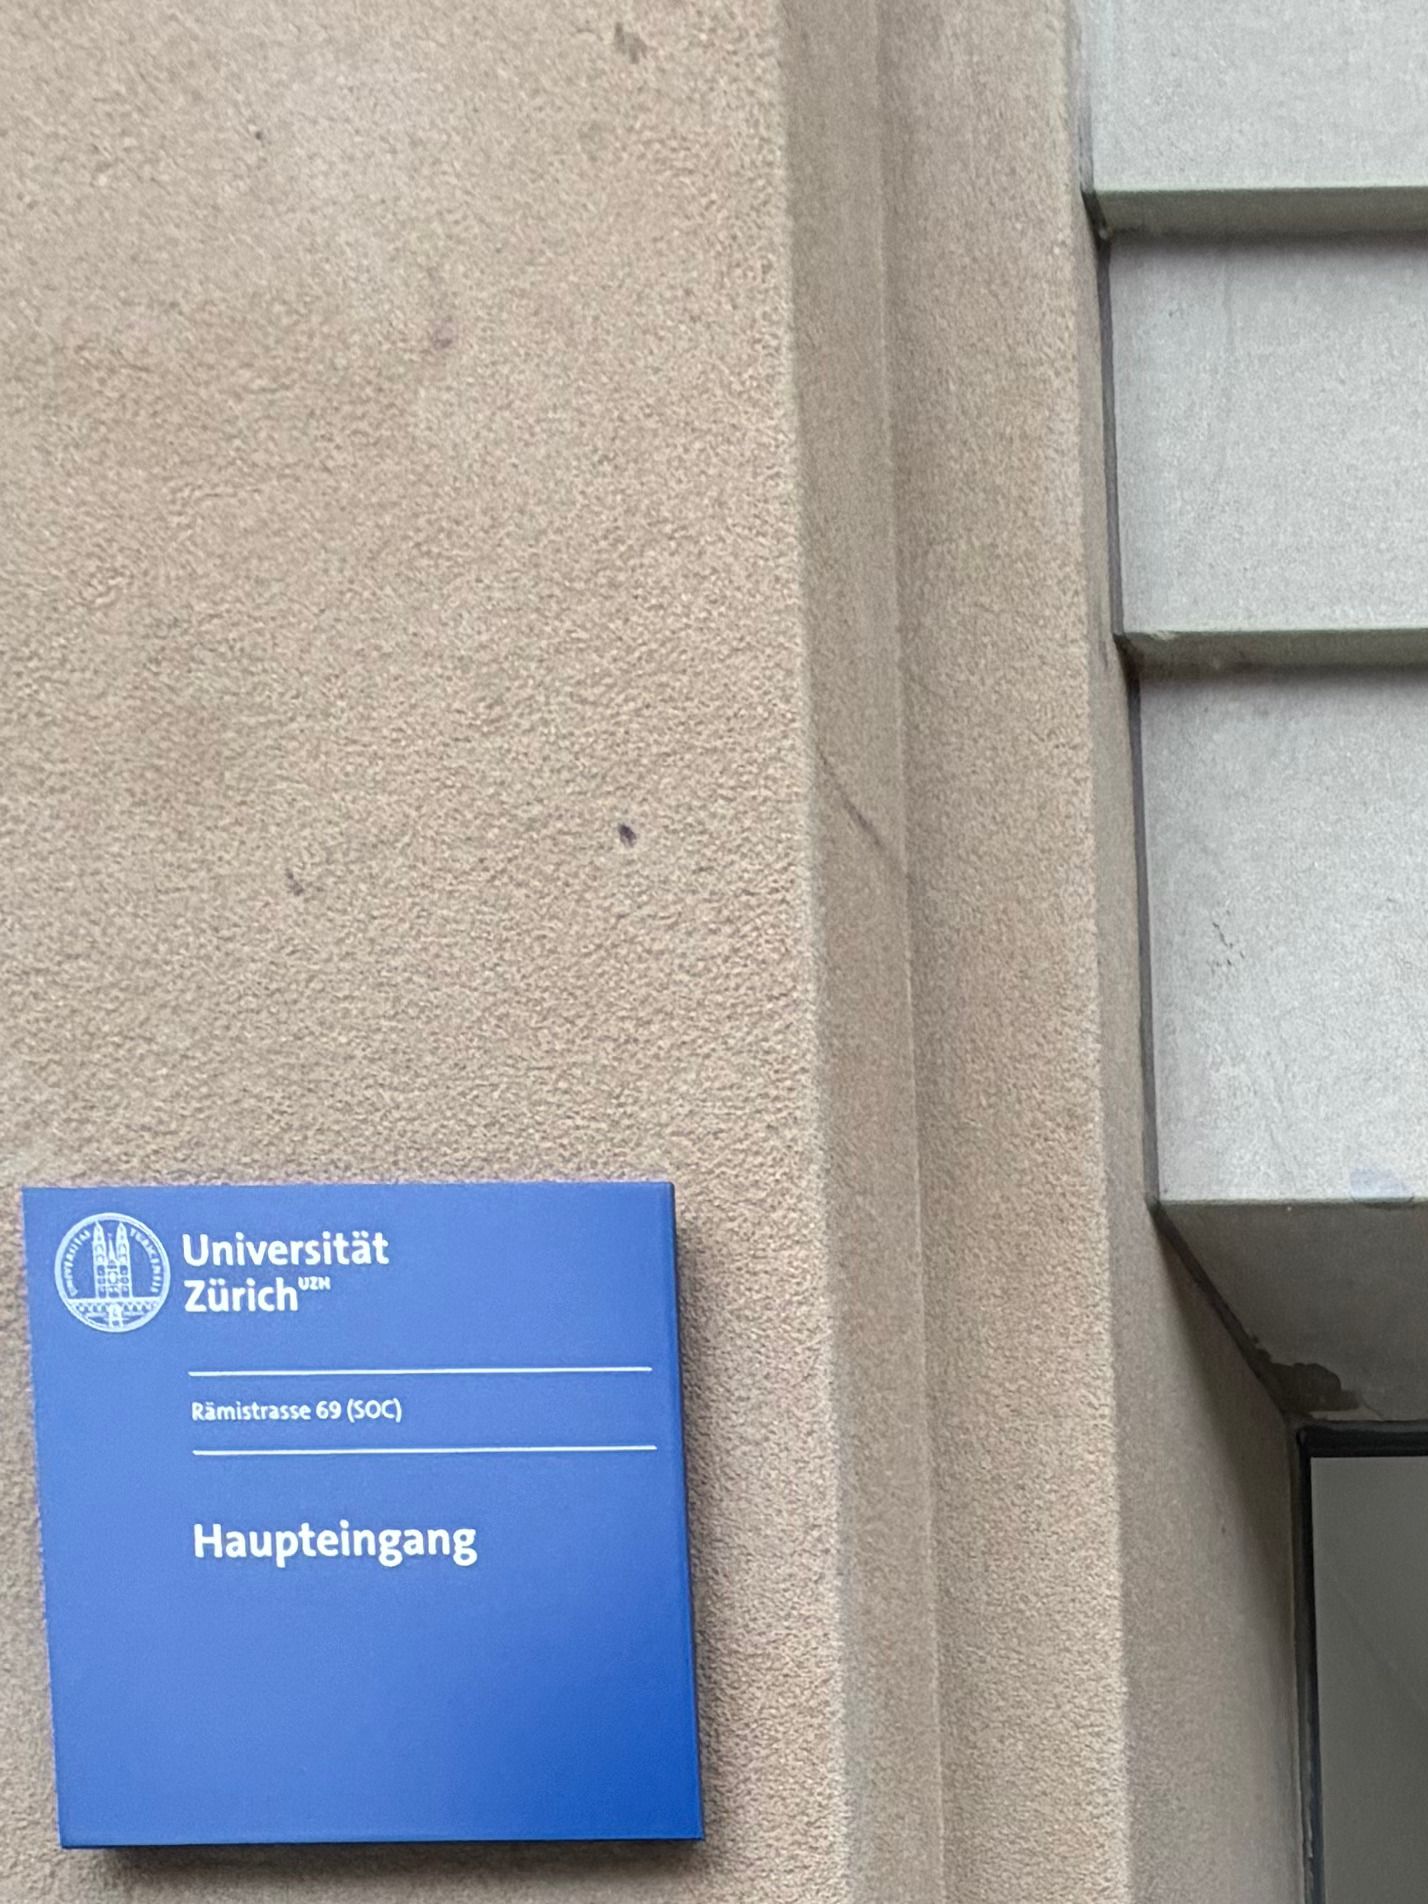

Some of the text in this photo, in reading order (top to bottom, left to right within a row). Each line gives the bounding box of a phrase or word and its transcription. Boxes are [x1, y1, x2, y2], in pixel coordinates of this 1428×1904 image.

[182, 1231, 390, 1267] Universität
[183, 1276, 299, 1313] Zürich
[191, 1398, 402, 1424] Rämistrasse 69 (SOC)
[193, 1519, 479, 1569] Haupteingang
